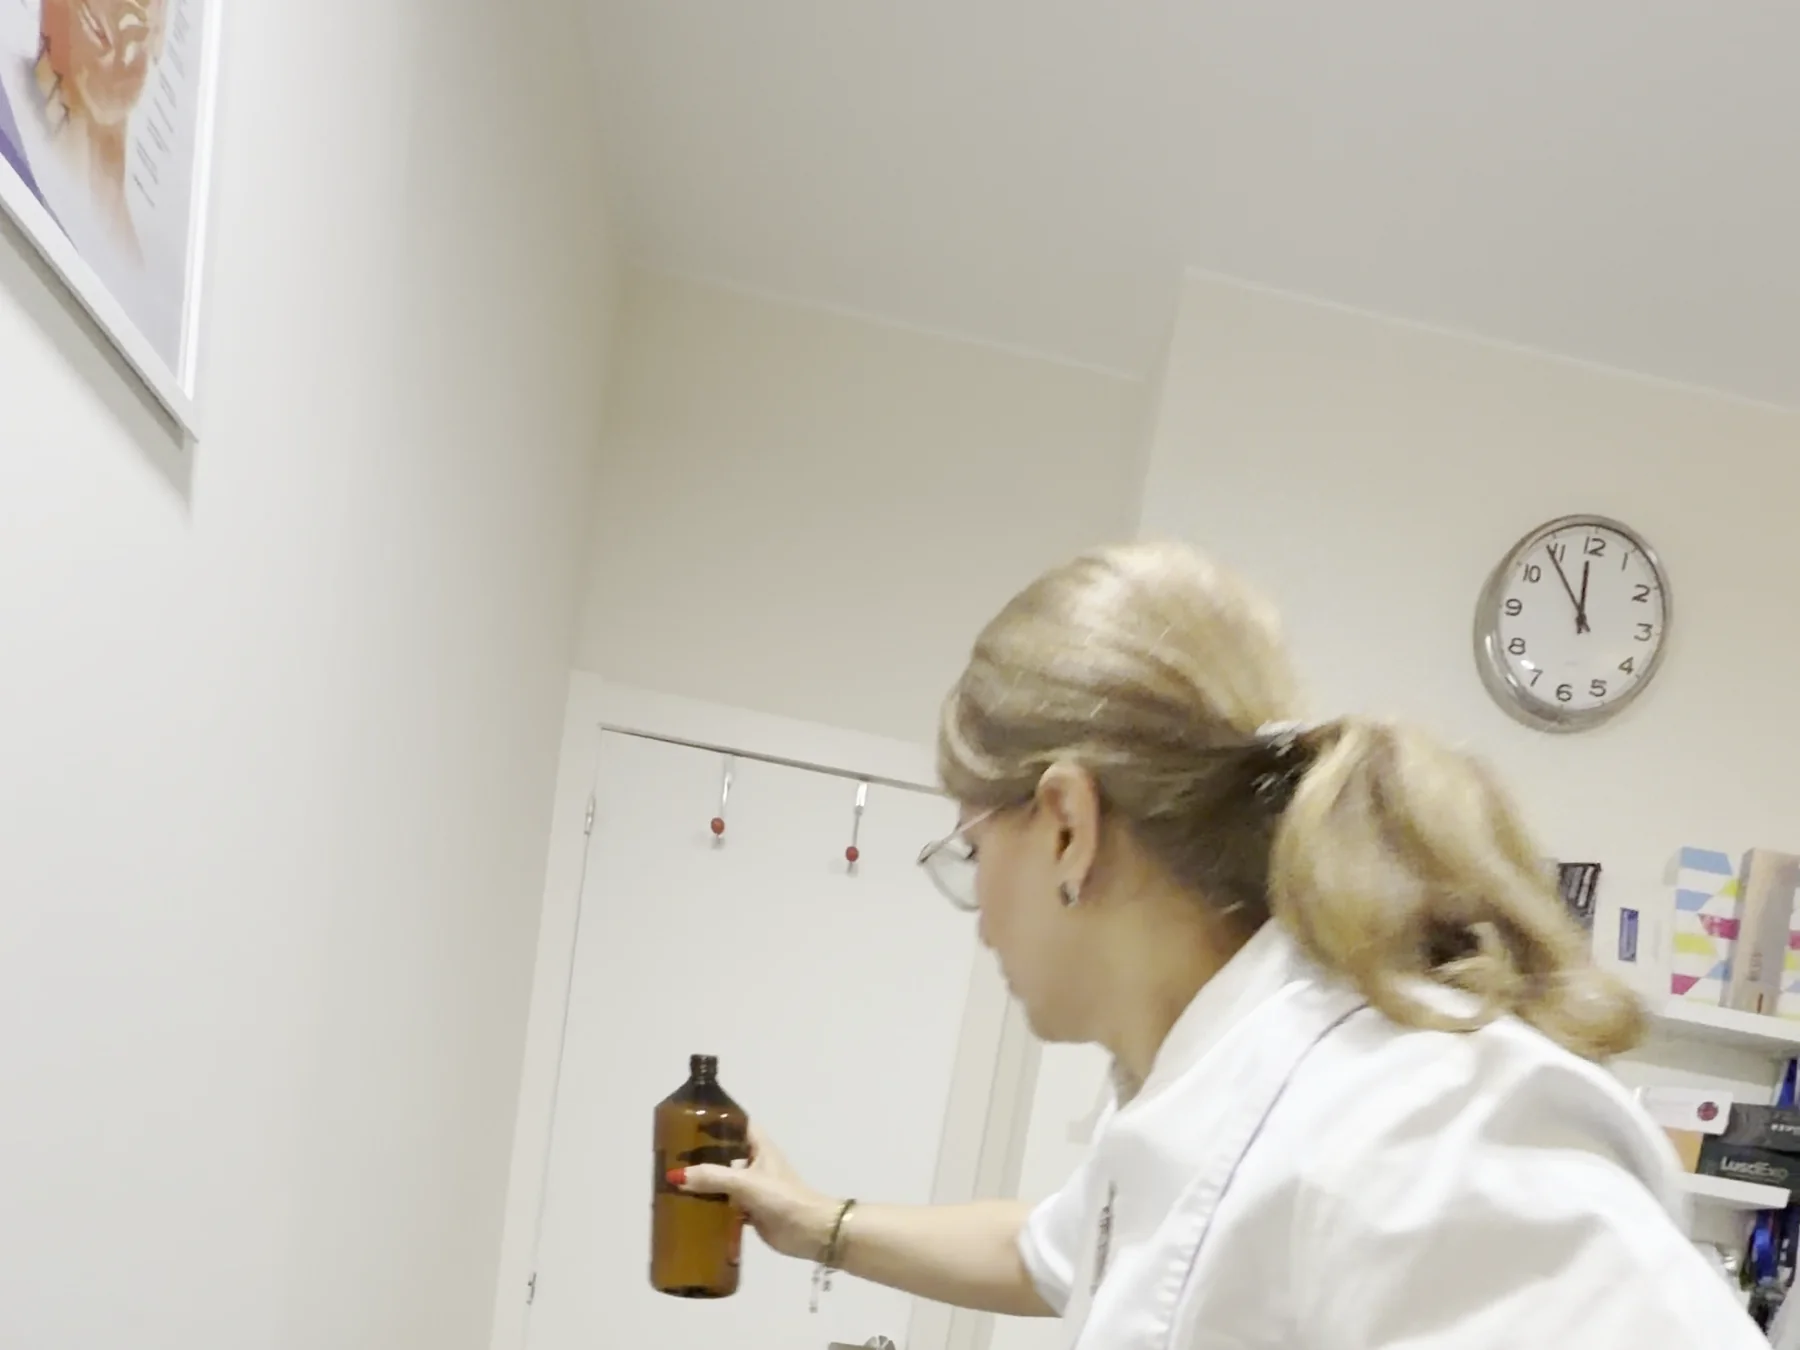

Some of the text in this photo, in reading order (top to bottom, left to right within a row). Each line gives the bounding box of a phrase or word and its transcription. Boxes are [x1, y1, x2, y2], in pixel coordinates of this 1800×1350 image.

[1584, 536, 1606, 557] 12
[1621, 552, 1628, 571] 1
[1522, 564, 1542, 583] 10
[1632, 584, 1650, 603] 2
[1504, 598, 1522, 616] 9
[1634, 623, 1653, 642] 3
[1508, 638, 1526, 656] 8
[1618, 656, 1634, 675] 4
[1530, 668, 1543, 688] 7
[1556, 684, 1574, 702] 6
[1588, 678, 1607, 698] 5
